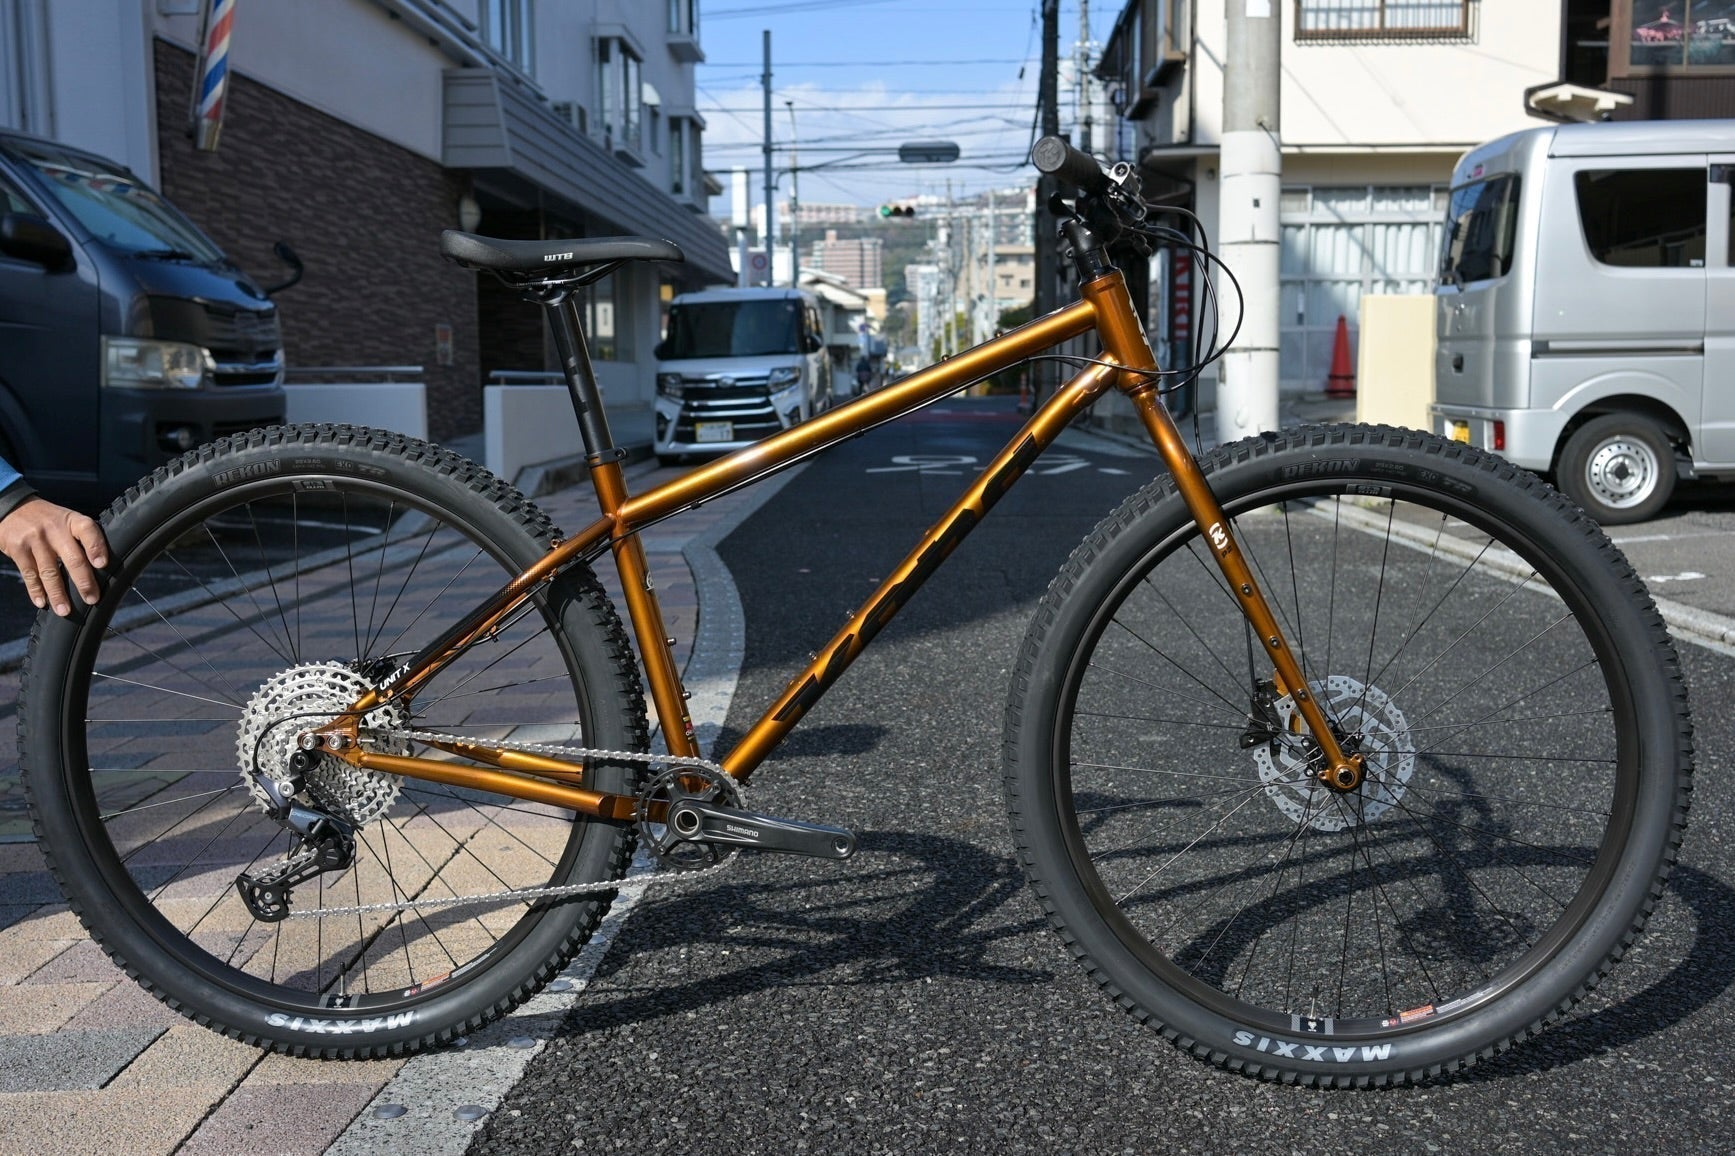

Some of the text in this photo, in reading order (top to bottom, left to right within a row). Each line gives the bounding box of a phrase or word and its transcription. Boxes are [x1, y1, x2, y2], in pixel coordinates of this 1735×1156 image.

[544, 252, 574, 262] WTB
[1174, 255, 1191, 340] KIRI
[212, 458, 282, 487] REKON
[1281, 458, 1361, 479] REKON
[379, 661, 411, 691] UNIT X
[726, 824, 759, 838] SHIMANO
[265, 1009, 415, 1034] MAXXIS
[1233, 1030, 1392, 1063] MAXXIS
